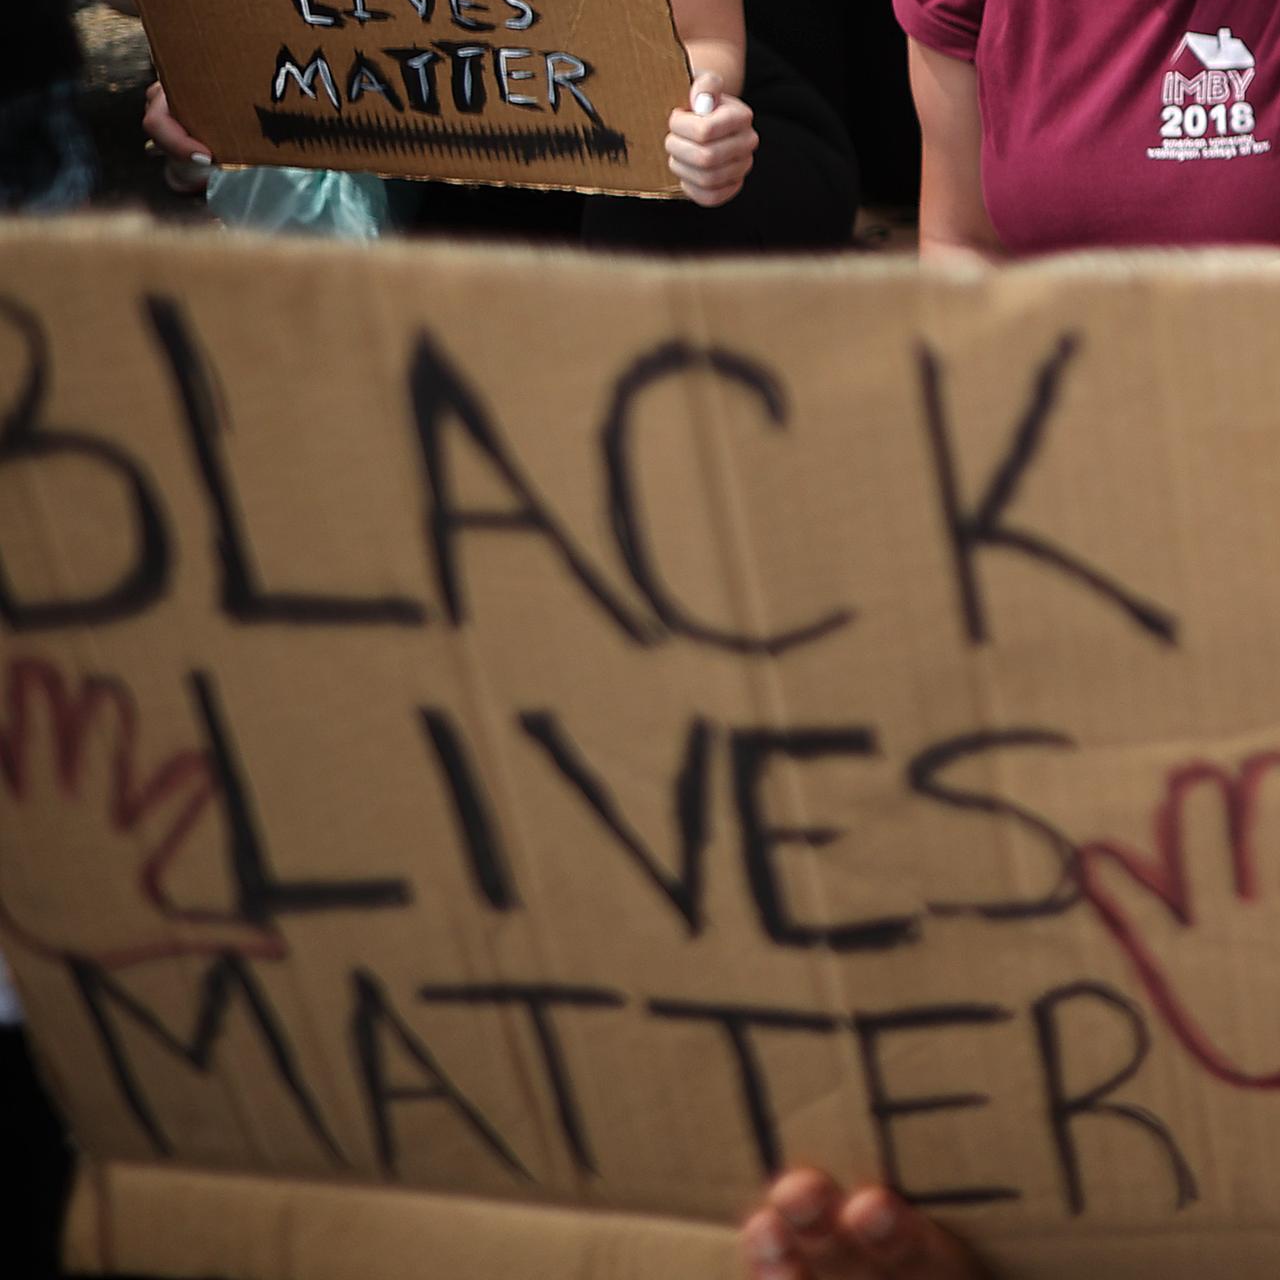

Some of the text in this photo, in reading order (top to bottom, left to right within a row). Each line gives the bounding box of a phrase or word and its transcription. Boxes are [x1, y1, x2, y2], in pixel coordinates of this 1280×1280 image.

[270, 42, 606, 132] MATTER
[1159, 102, 1255, 138] 2018
[1162, 68, 1255, 105] IMBY
[0, 292, 1184, 656] BLACK
[188, 670, 1086, 952] LIVES
[64, 948, 1202, 1216] MATTER
